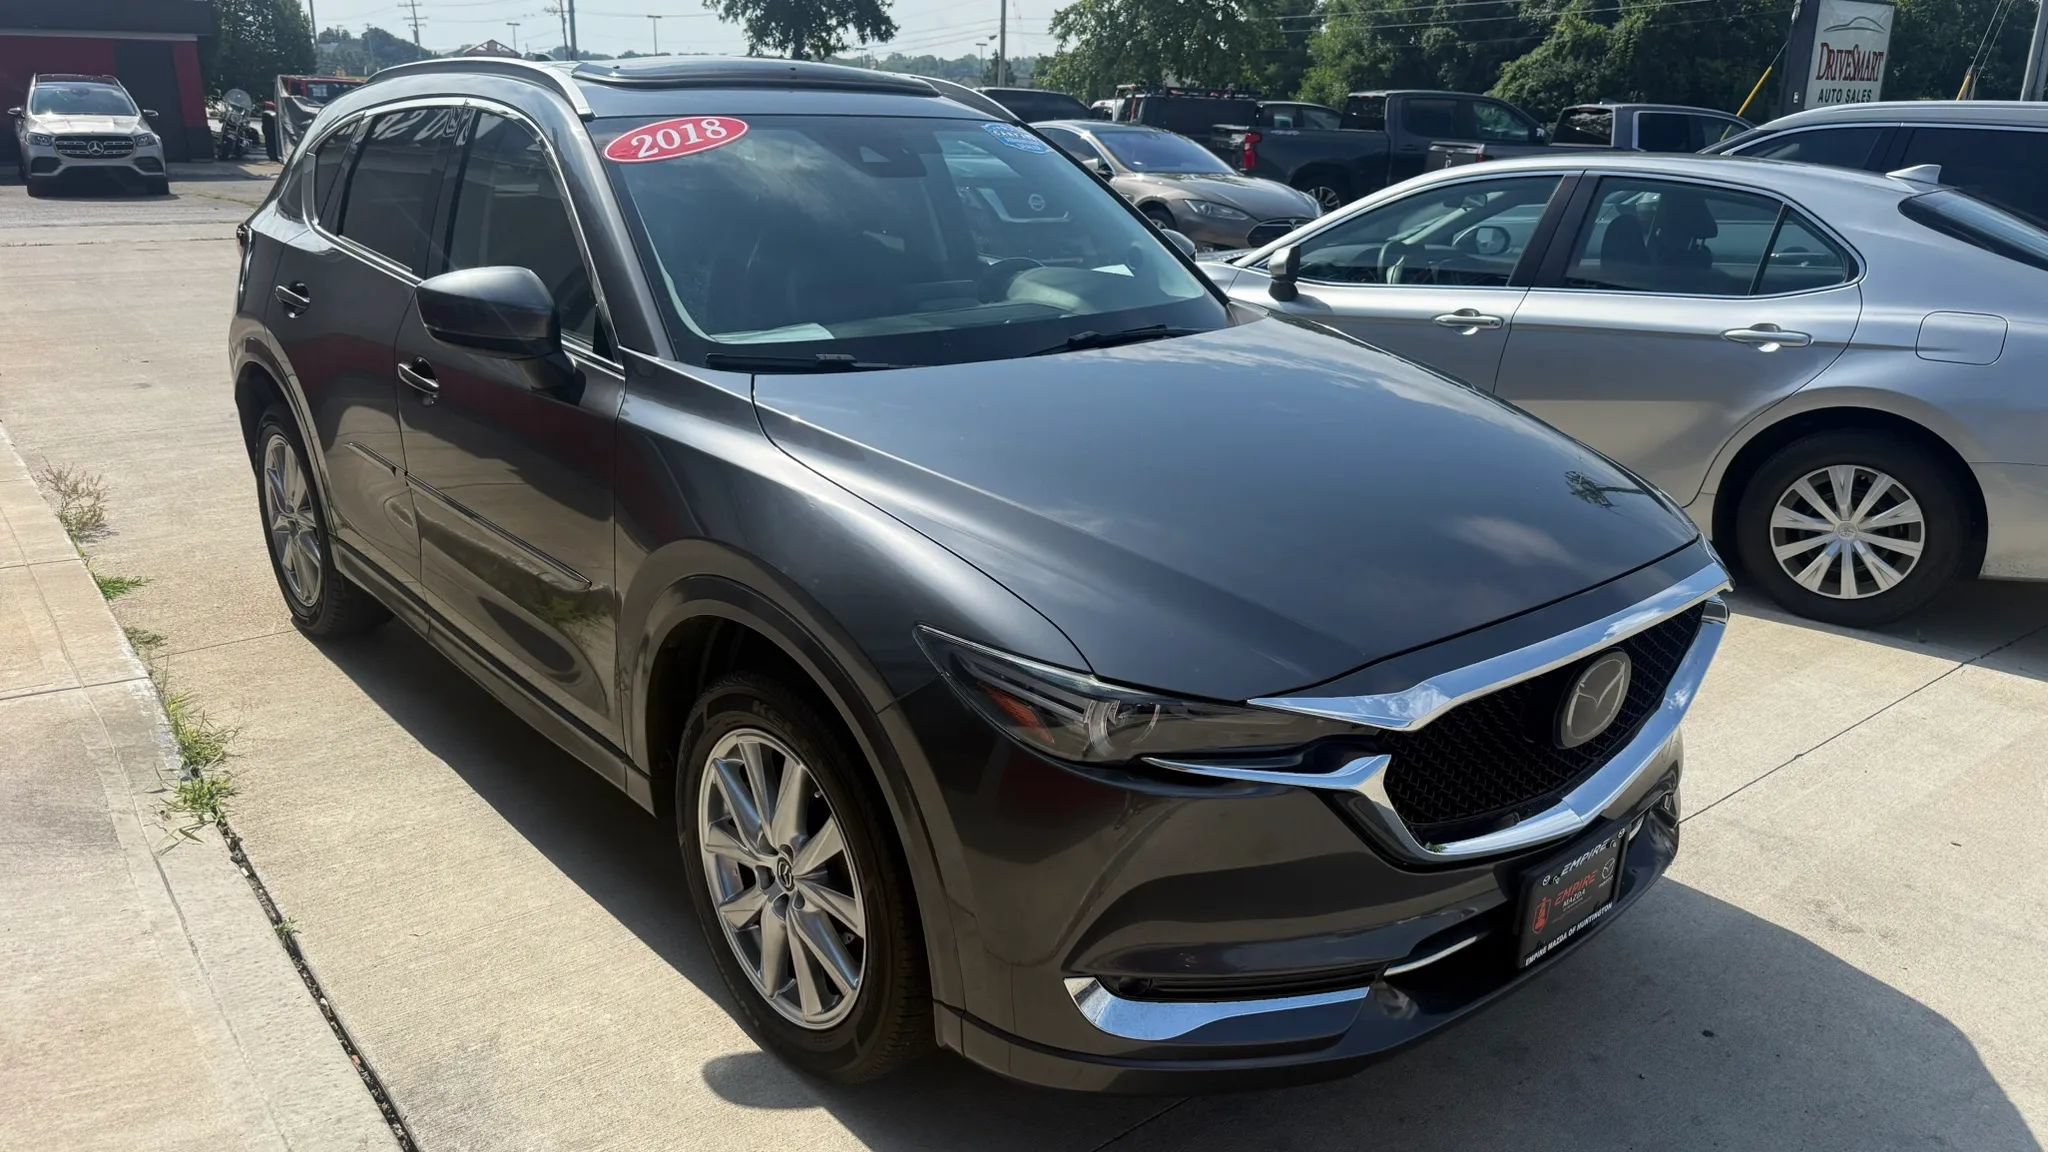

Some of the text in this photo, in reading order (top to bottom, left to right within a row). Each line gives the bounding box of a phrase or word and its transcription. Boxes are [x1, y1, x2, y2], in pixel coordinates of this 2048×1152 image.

[1817, 88, 1872, 103] AUTO SALES
[630, 118, 728, 159] 2018
[1560, 838, 1610, 877] EMPIRE
[1552, 869, 1598, 906] EMPIRE
[1562, 888, 1586, 908] MAZDA
[1525, 945, 1547, 967] EMPIRE
[1547, 932, 1568, 951] MAZDA
[1568, 925, 1577, 937] OF
[1577, 902, 1613, 931] HUNTINGTON
